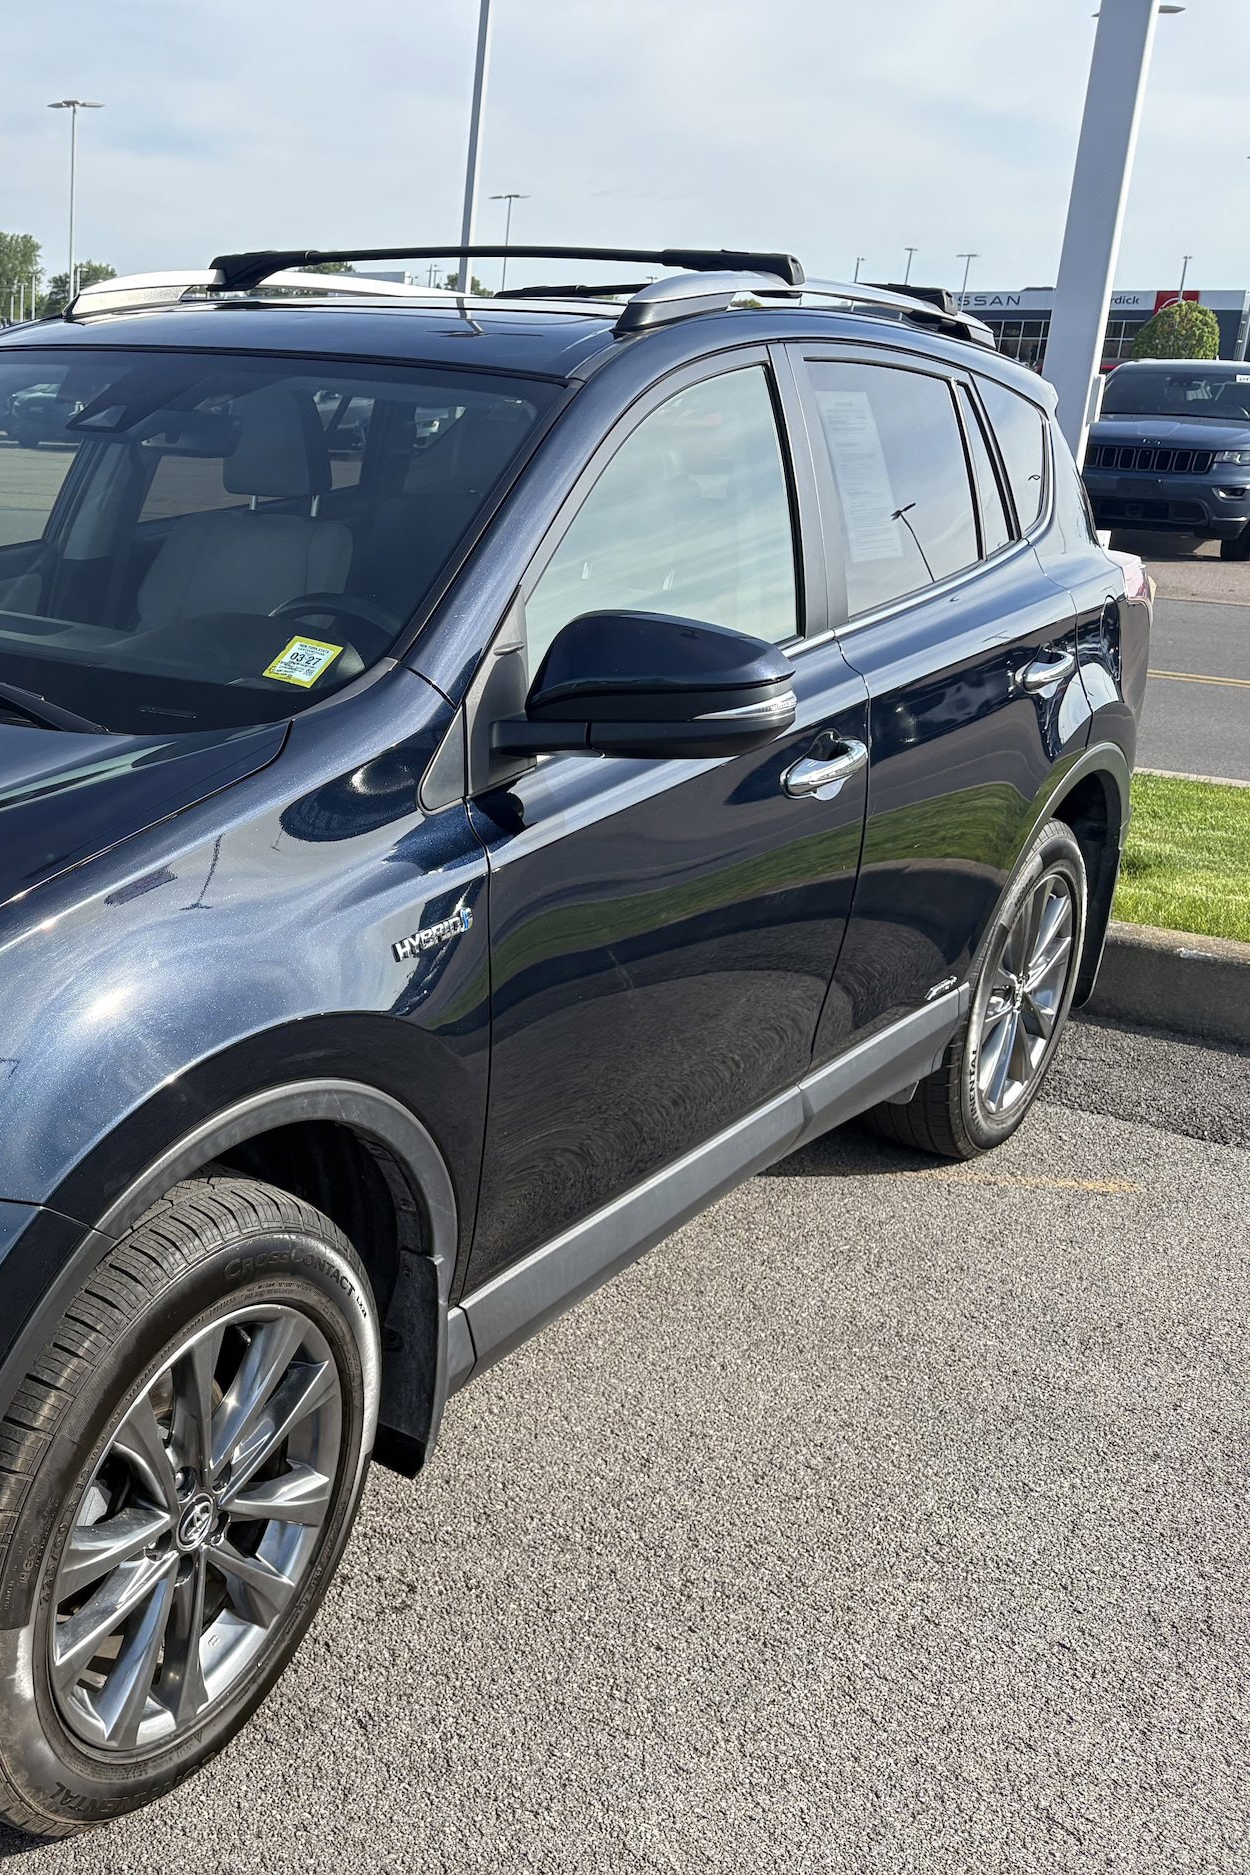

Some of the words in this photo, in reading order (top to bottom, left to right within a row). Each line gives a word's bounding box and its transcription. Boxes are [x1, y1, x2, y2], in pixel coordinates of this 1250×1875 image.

[957, 295, 1021, 306] SSAN
[1111, 295, 1140, 305] rdick
[391, 915, 463, 963] HYBRID
